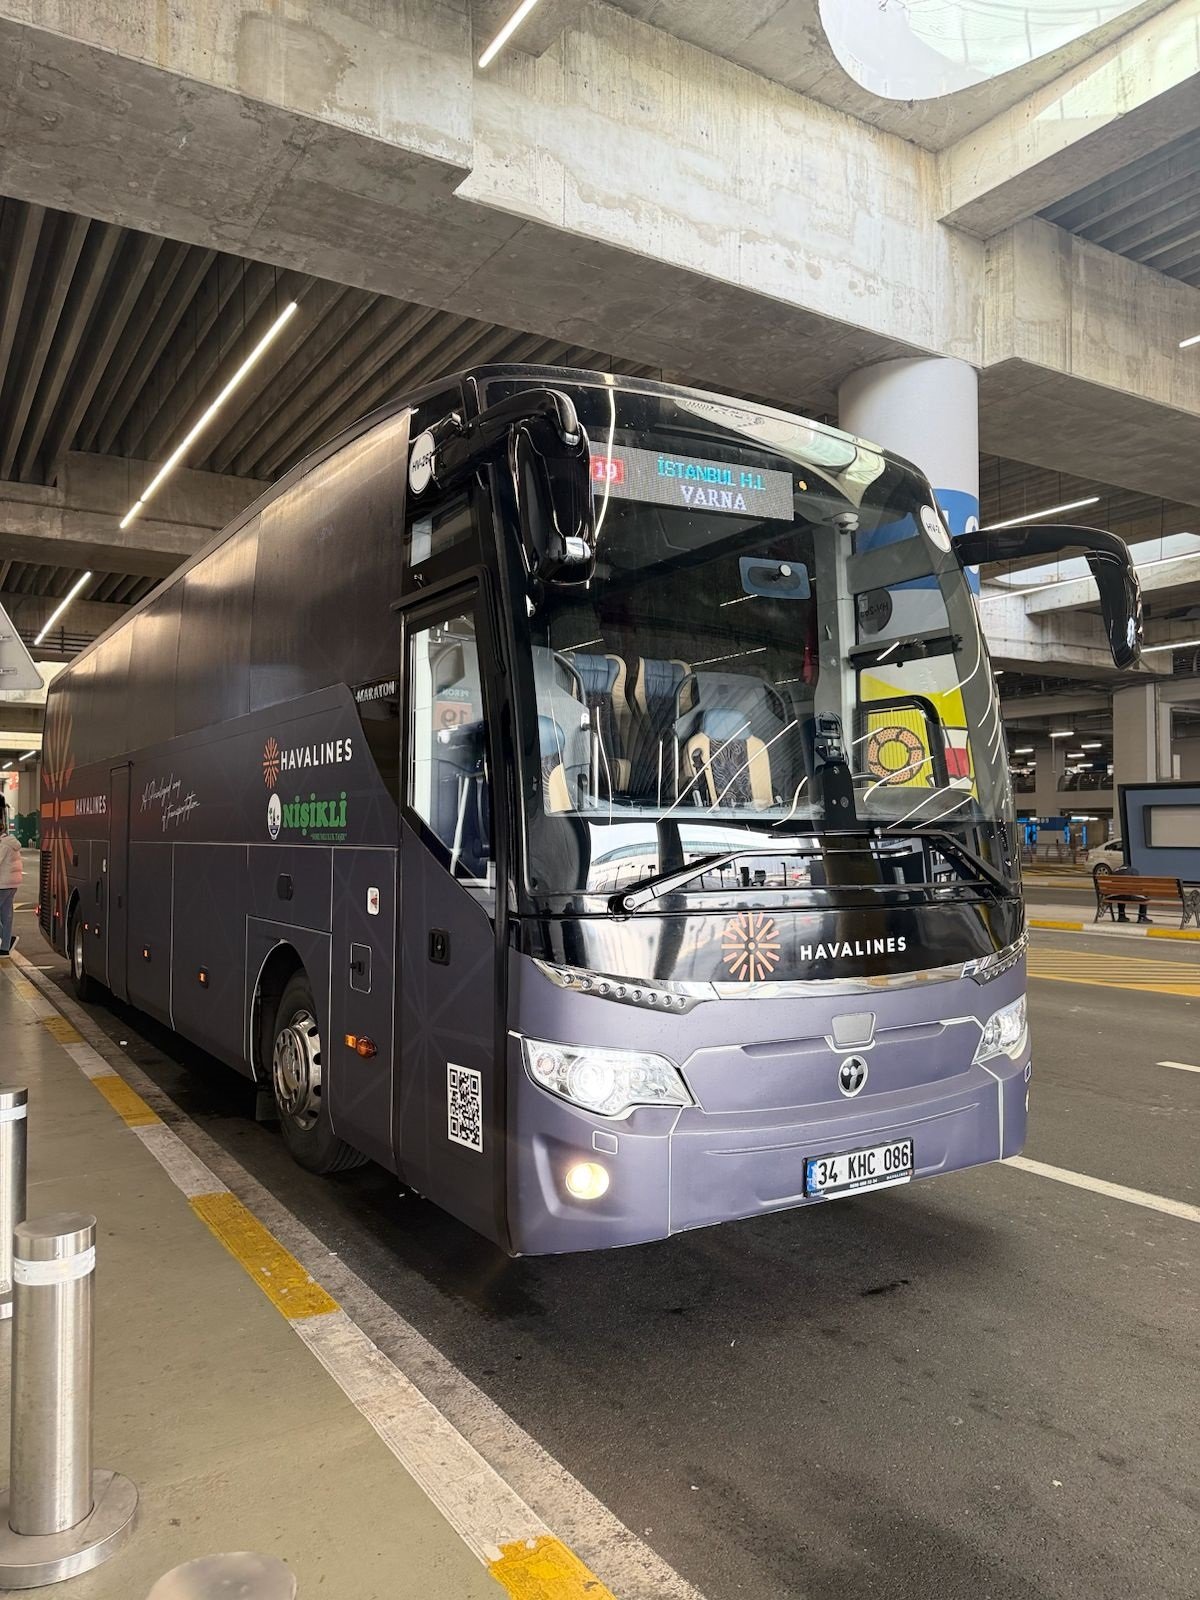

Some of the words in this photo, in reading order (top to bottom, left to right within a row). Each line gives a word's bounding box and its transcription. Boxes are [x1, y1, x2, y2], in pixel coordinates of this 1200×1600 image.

[595, 460, 617, 479] 19
[657, 456, 737, 487] İSTANBUL
[680, 485, 748, 511] VARNA
[354, 680, 395, 703] MARATON
[280, 737, 353, 771] HAVALINES
[75, 794, 107, 816] HAVALINES
[282, 791, 348, 836] NİŞİKLİ
[800, 936, 907, 961] HAVALINES
[818, 1160, 838, 1186] 34
[848, 1152, 876, 1179] KHC
[884, 1144, 909, 1171] 086
